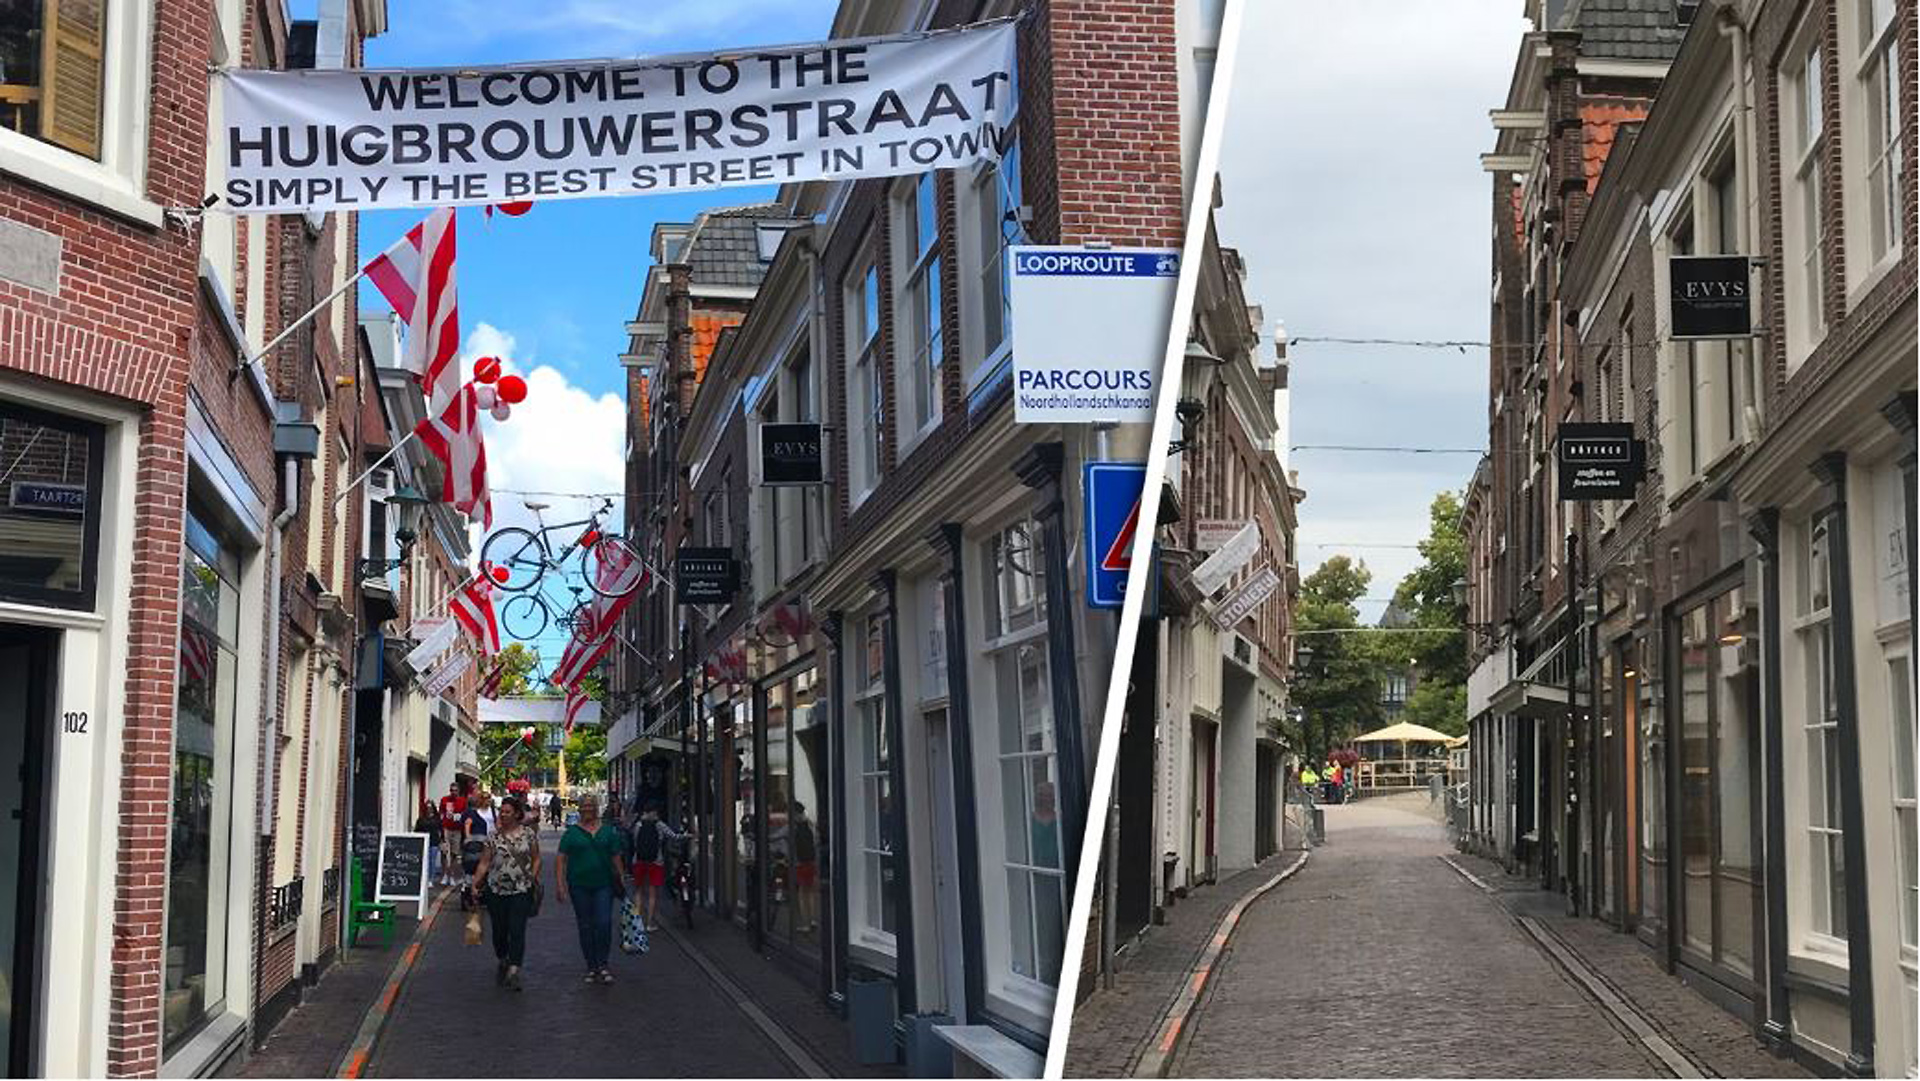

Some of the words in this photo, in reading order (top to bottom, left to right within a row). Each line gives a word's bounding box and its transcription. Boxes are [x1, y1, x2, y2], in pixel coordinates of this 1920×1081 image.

[360, 68, 645, 111] WELCOME
[674, 60, 740, 97] TO
[758, 46, 869, 89] THE
[229, 71, 1008, 168] HUIGBROUWERSTRAAT
[227, 175, 389, 208] SIMPLY
[402, 173, 488, 201] THE
[504, 167, 616, 196] BEST
[632, 153, 805, 189] STREET
[821, 145, 864, 172] IN
[879, 126, 1004, 166] TOWN
[1017, 256, 1135, 272] LOOPROUTE
[1686, 281, 1744, 298] EVYS
[1019, 370, 1152, 390] PARCOURS
[774, 442, 818, 455] EVYS
[64, 711, 87, 733] 102
